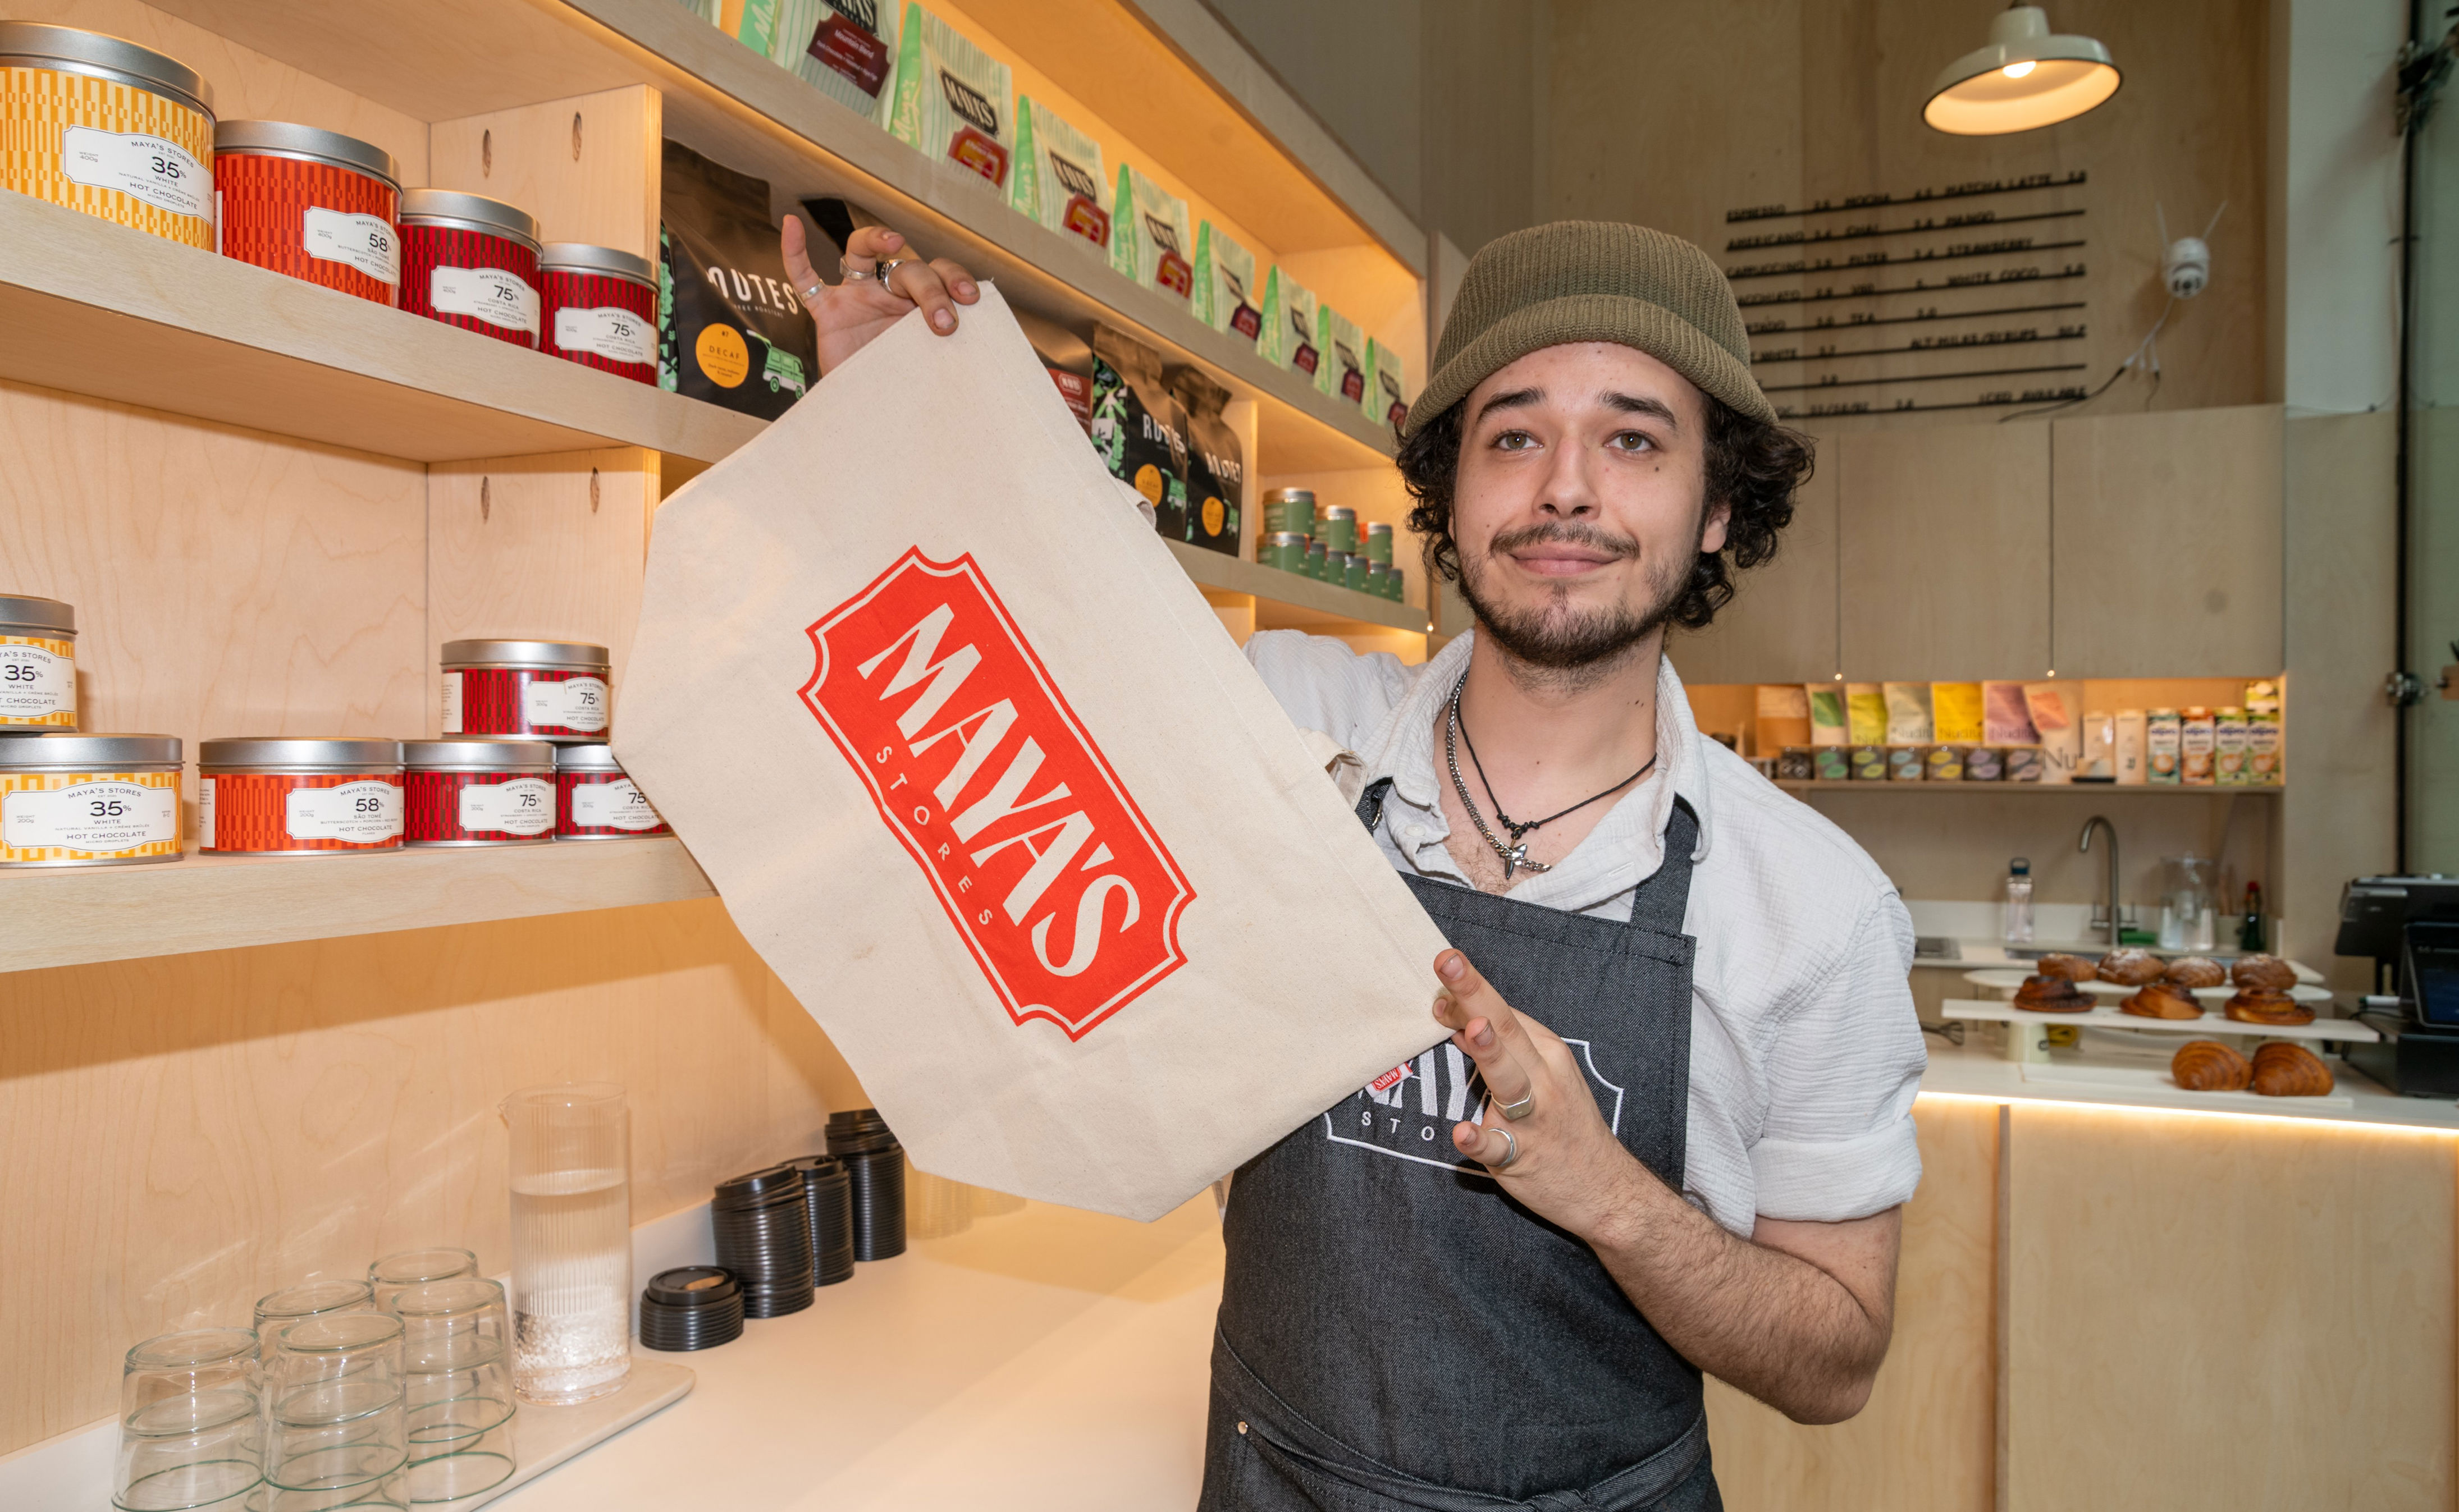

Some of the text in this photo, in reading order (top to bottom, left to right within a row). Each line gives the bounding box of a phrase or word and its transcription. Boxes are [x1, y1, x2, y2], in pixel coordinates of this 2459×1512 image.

[131, 141, 194, 168] MAYA'S STORES
[152, 156, 186, 179] 35%
[118, 172, 144, 181] NATURAL
[145, 178, 167, 189] VANILLA
[155, 175, 179, 187] WHITE
[1945, 180, 2002, 198] MATCHA
[130, 182, 150, 192] HOT
[153, 188, 198, 210] CHOCOLATE
[1727, 231, 1805, 250] AMERICANO
[1946, 237, 2033, 259] STRAWBERRY
[355, 255, 368, 264] HOT
[505, 277, 525, 292] STORES
[1739, 289, 1801, 306] ACCHIATO
[494, 310, 528, 324] CHOCOLATE
[709, 345, 741, 360] DECAF
[22, 652, 51, 664] STORES
[4, 665, 43, 681] 35%
[68, 787, 141, 799] MAYA'S STORES
[340, 786, 390, 796] MAYA'S STORES
[506, 784, 528, 792] MAYA'S
[856, 602, 1140, 977] MAYA'S
[356, 798, 385, 812] 58%
[628, 792, 646, 804] 75
[90, 800, 132, 817] 35%
[875, 745, 994, 927] STORES
[1374, 1067, 1398, 1089] MAYA'S
[1361, 1111, 1435, 1141] STO
